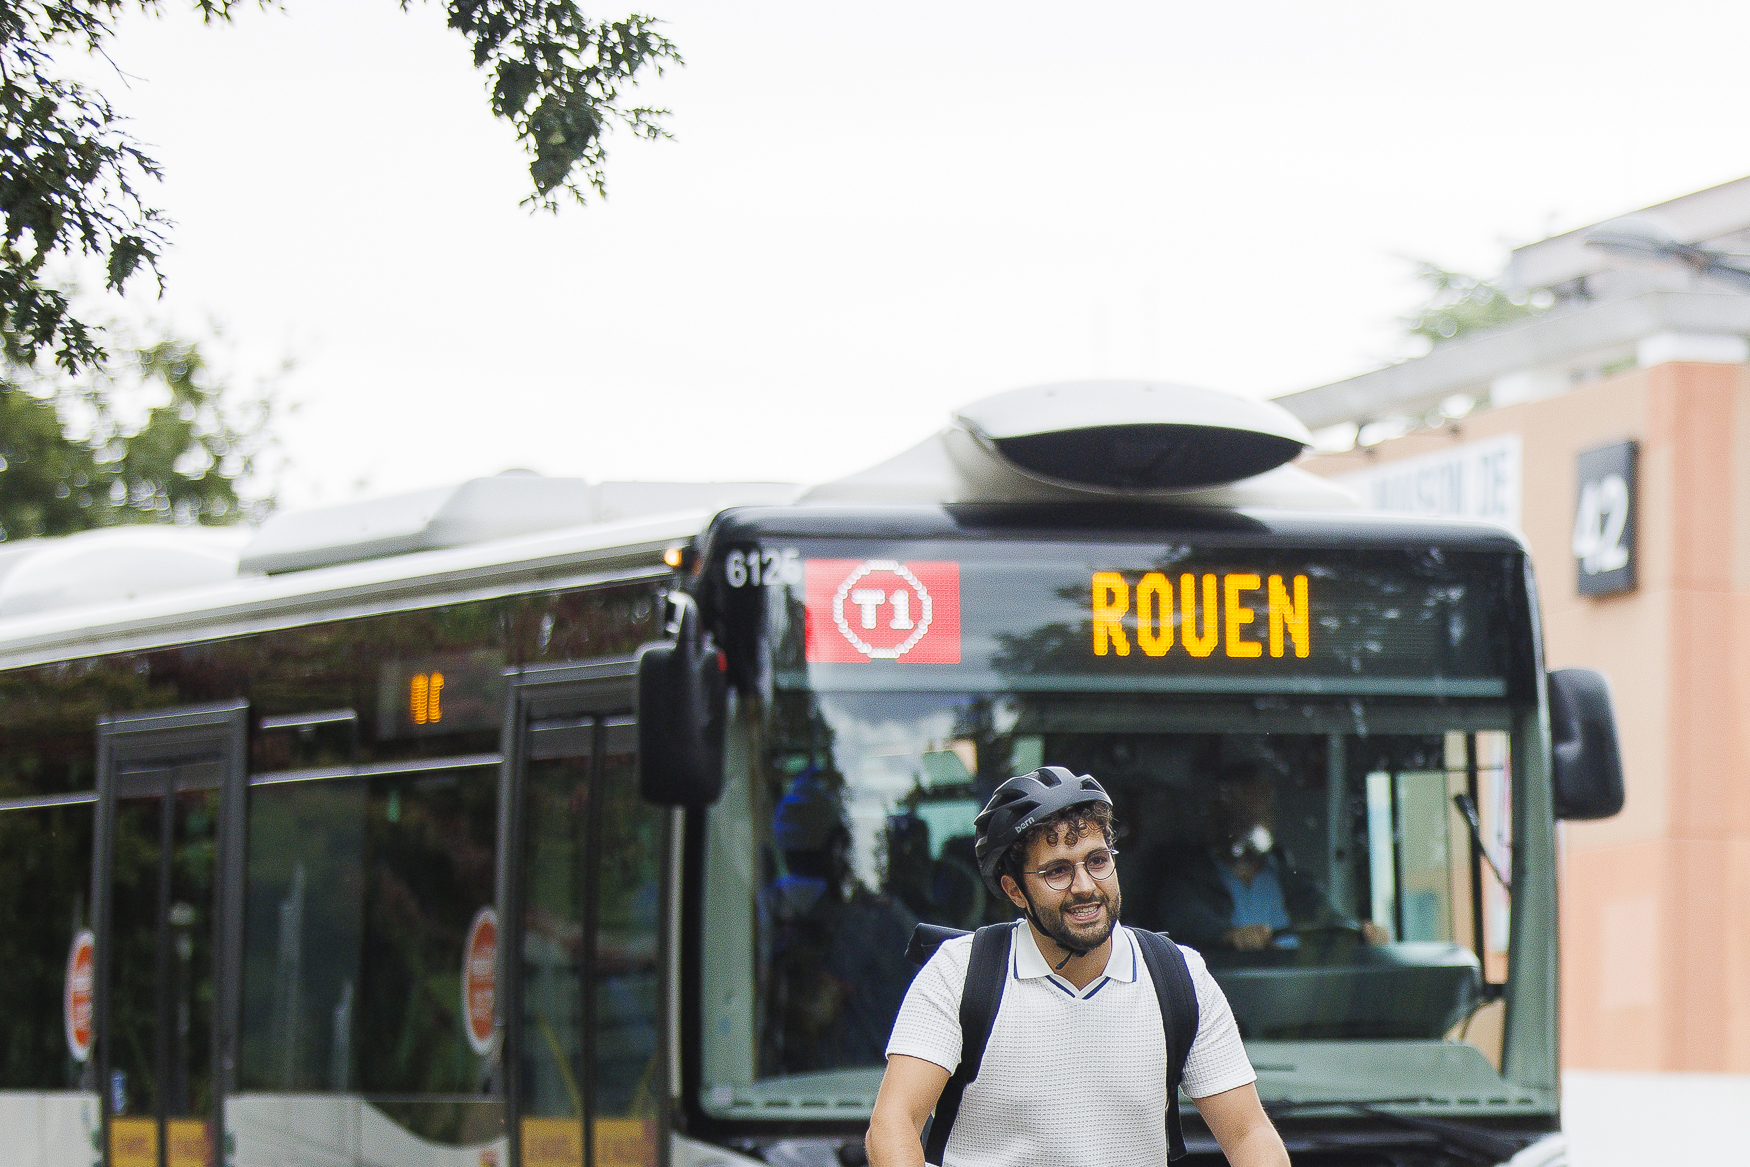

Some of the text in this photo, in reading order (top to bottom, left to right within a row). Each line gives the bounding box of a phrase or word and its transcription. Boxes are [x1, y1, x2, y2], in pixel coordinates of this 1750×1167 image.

[1573, 476, 1629, 575] 42
[851, 589, 915, 630] T1
[1092, 571, 1310, 658] ROUEN
[1014, 816, 1036, 834] bern
